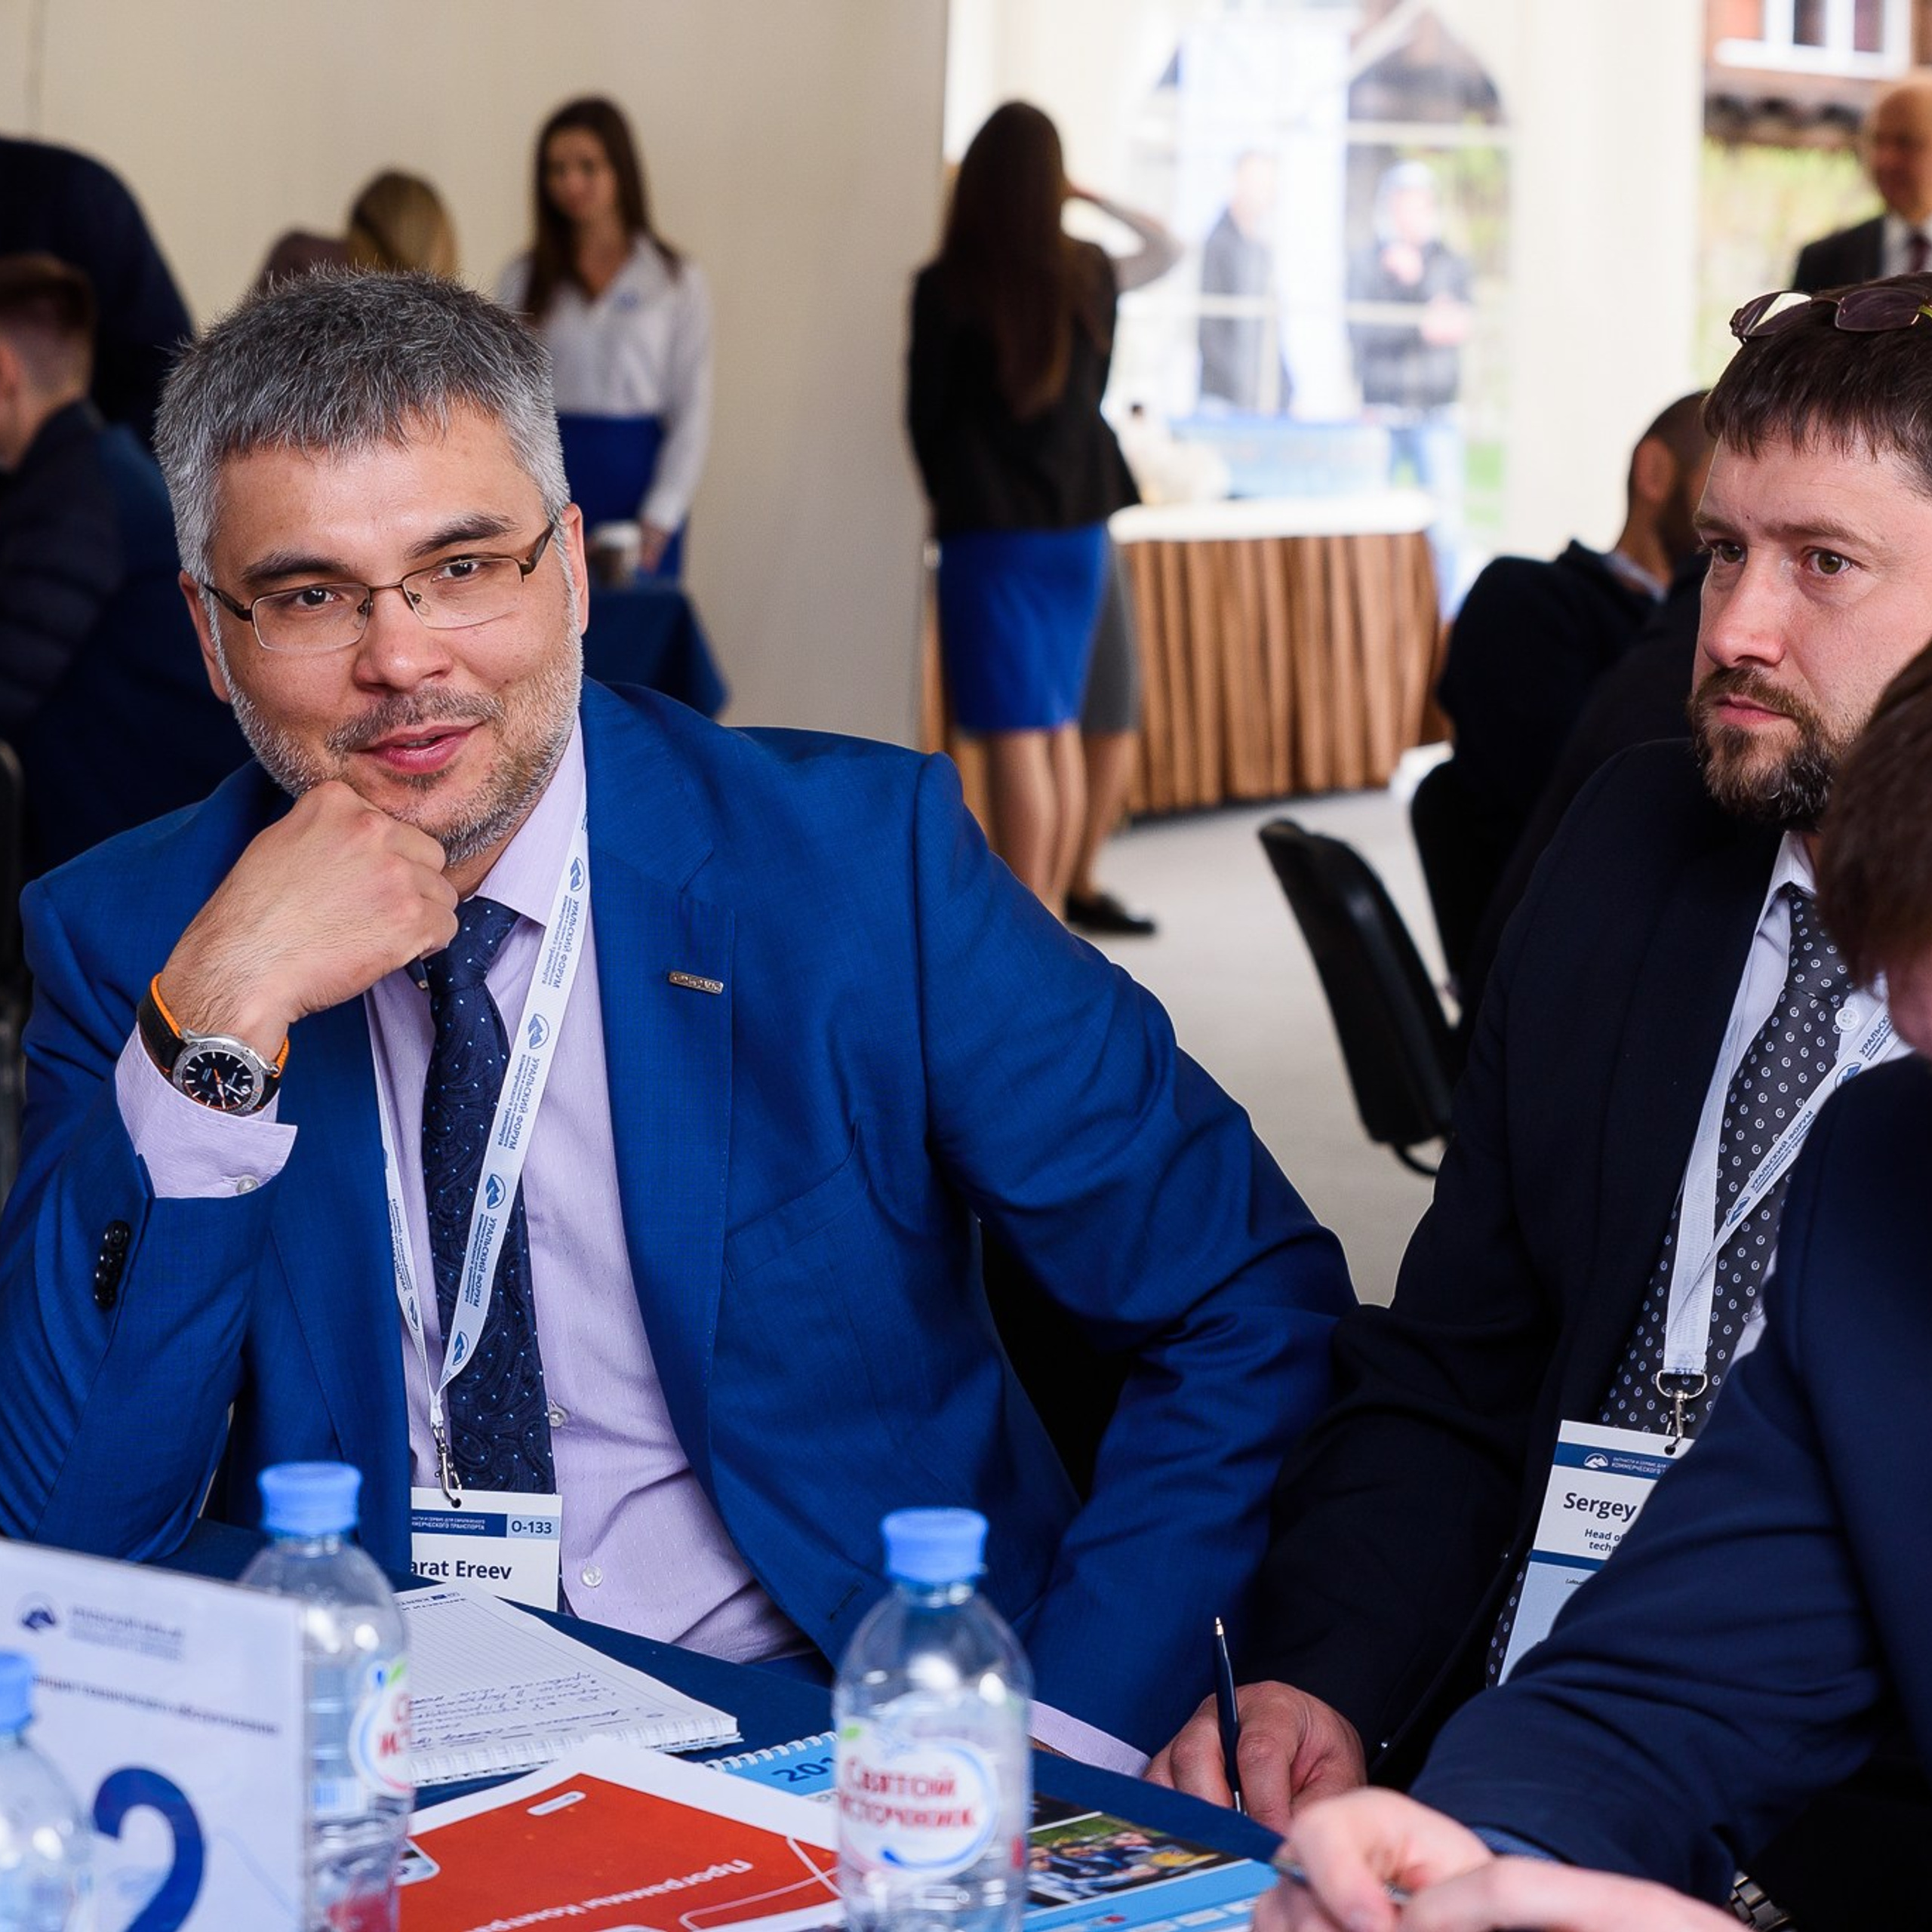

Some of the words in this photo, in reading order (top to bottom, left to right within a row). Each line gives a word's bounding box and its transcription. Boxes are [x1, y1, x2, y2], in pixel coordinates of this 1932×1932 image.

[564, 899, 580, 952] УРАЛЬСКИЙ
[552, 954, 568, 989] ФОРУМ
[518, 1057, 540, 1113] УРАЛЬСКИЙ
[508, 1115, 523, 1150] ФОРУМ
[1751, 1140, 1788, 1188] УРАЛЬСКИЙ
[1788, 1110, 1813, 1140] ФОРУМ
[478, 1217, 497, 1272] УРАЛЬСКИЙ
[472, 1275, 483, 1308] ФОРУМ
[1563, 1493, 1638, 1523] Sergey
[512, 1521, 552, 1534] O-133
[1585, 1528, 1612, 1540] Head
[411, 1560, 450, 1577] arat
[456, 1561, 512, 1580] Ereev
[93, 1767, 205, 1932] 2
